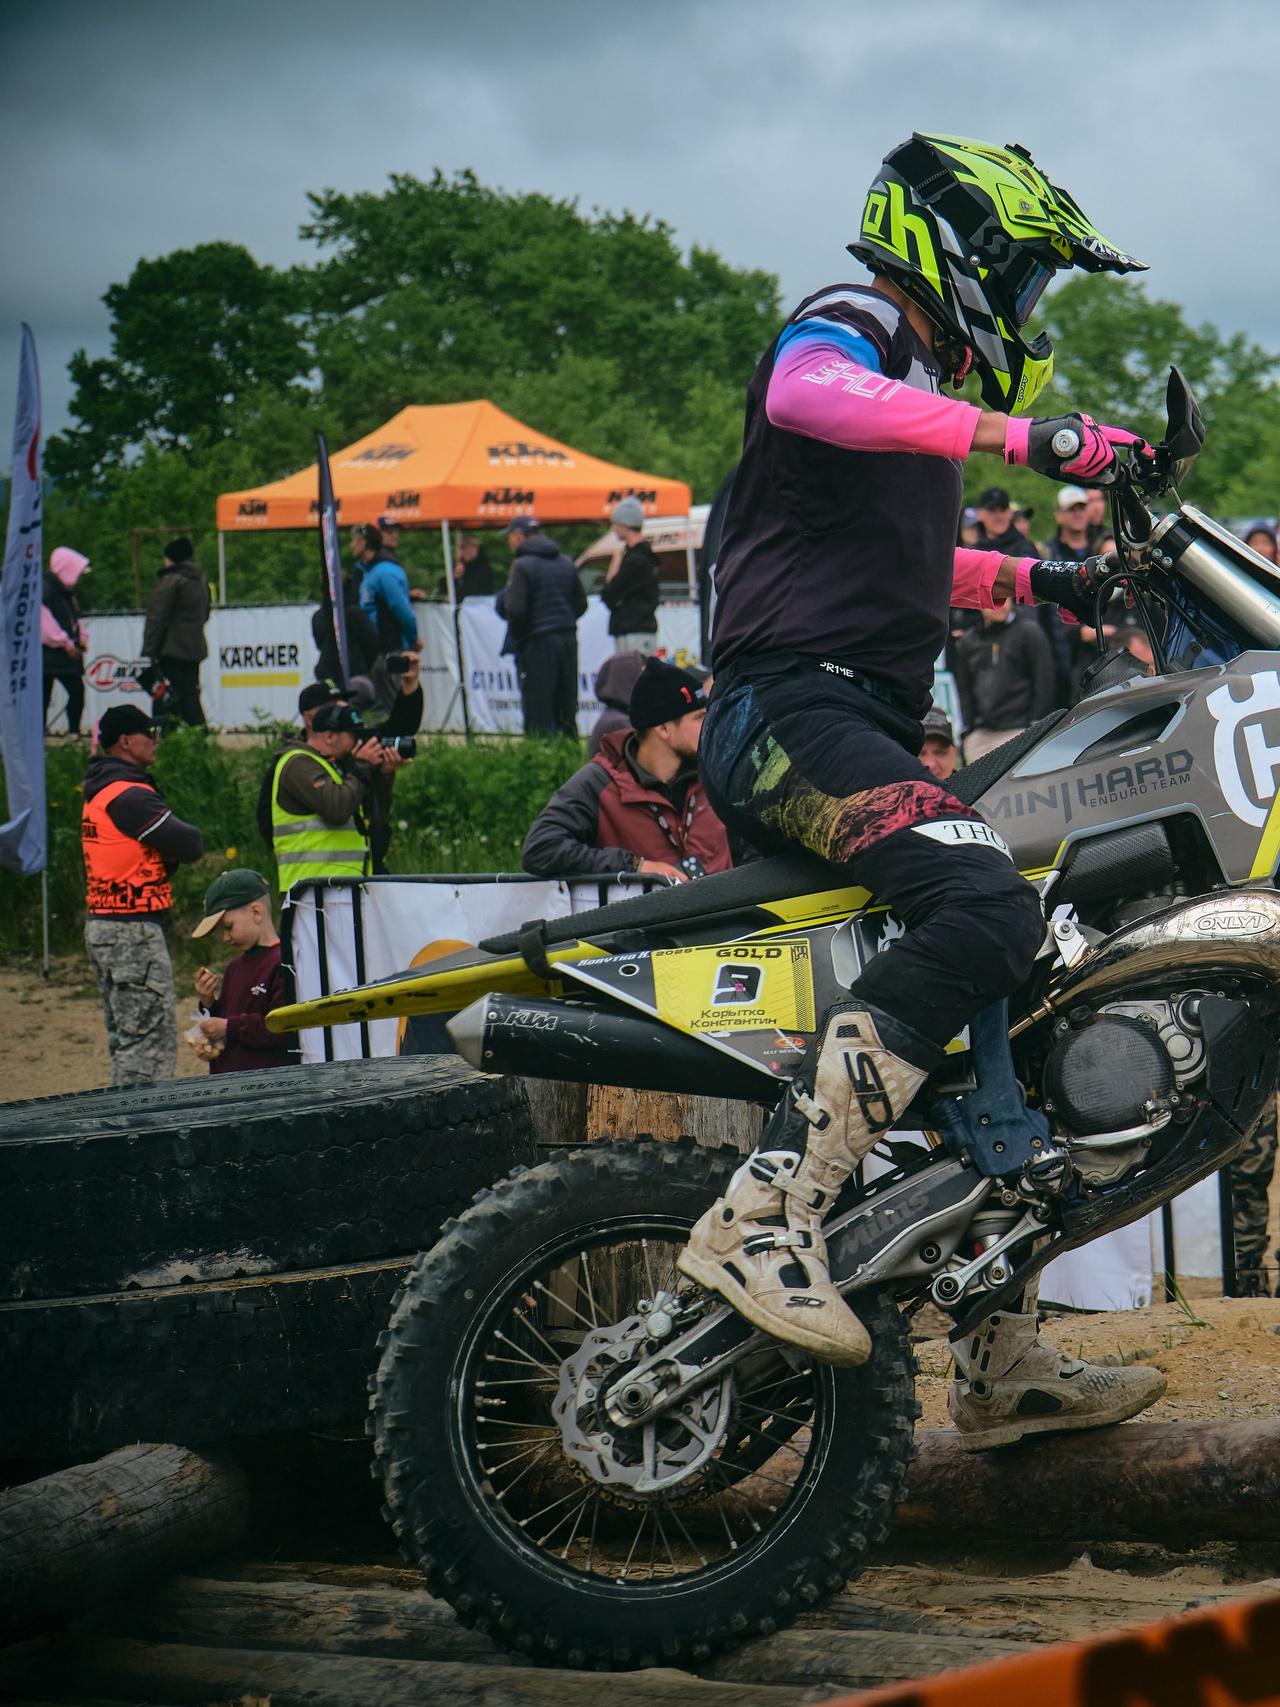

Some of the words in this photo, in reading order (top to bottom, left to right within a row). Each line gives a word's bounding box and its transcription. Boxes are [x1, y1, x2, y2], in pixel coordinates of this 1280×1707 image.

[386, 491, 421, 508] KTM
[481, 486, 535, 504] KTM
[237, 499, 268, 516] KTM
[220, 644, 299, 668] KÄRCHER
[1077, 749, 1195, 807] HARD
[1090, 785, 1148, 808] ENDURO
[1151, 773, 1191, 792] TEAM
[716, 947, 782, 960] GOLD
[505, 1009, 559, 1031] KTM
[701, 1008, 765, 1019] Корытко
[690, 1018, 777, 1029] Константин
